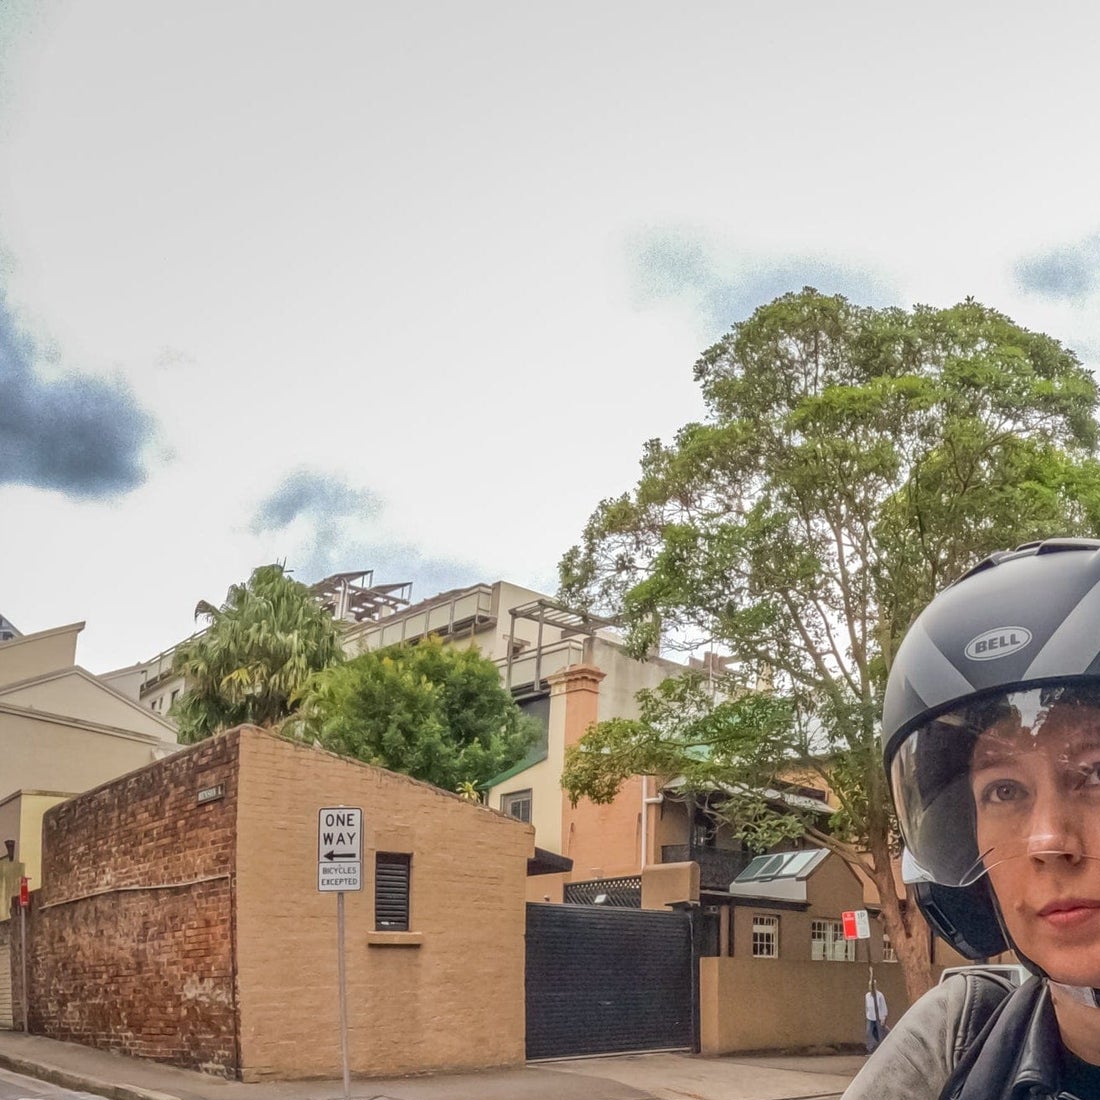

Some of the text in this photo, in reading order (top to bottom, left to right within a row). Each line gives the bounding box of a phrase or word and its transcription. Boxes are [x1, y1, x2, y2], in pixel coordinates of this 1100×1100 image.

[974, 633, 1021, 654] BELL
[325, 813, 355, 827] ONE
[323, 832, 356, 846] WAY
[322, 866, 357, 875] BICYCLES
[321, 877, 358, 886] EXCEPTED
